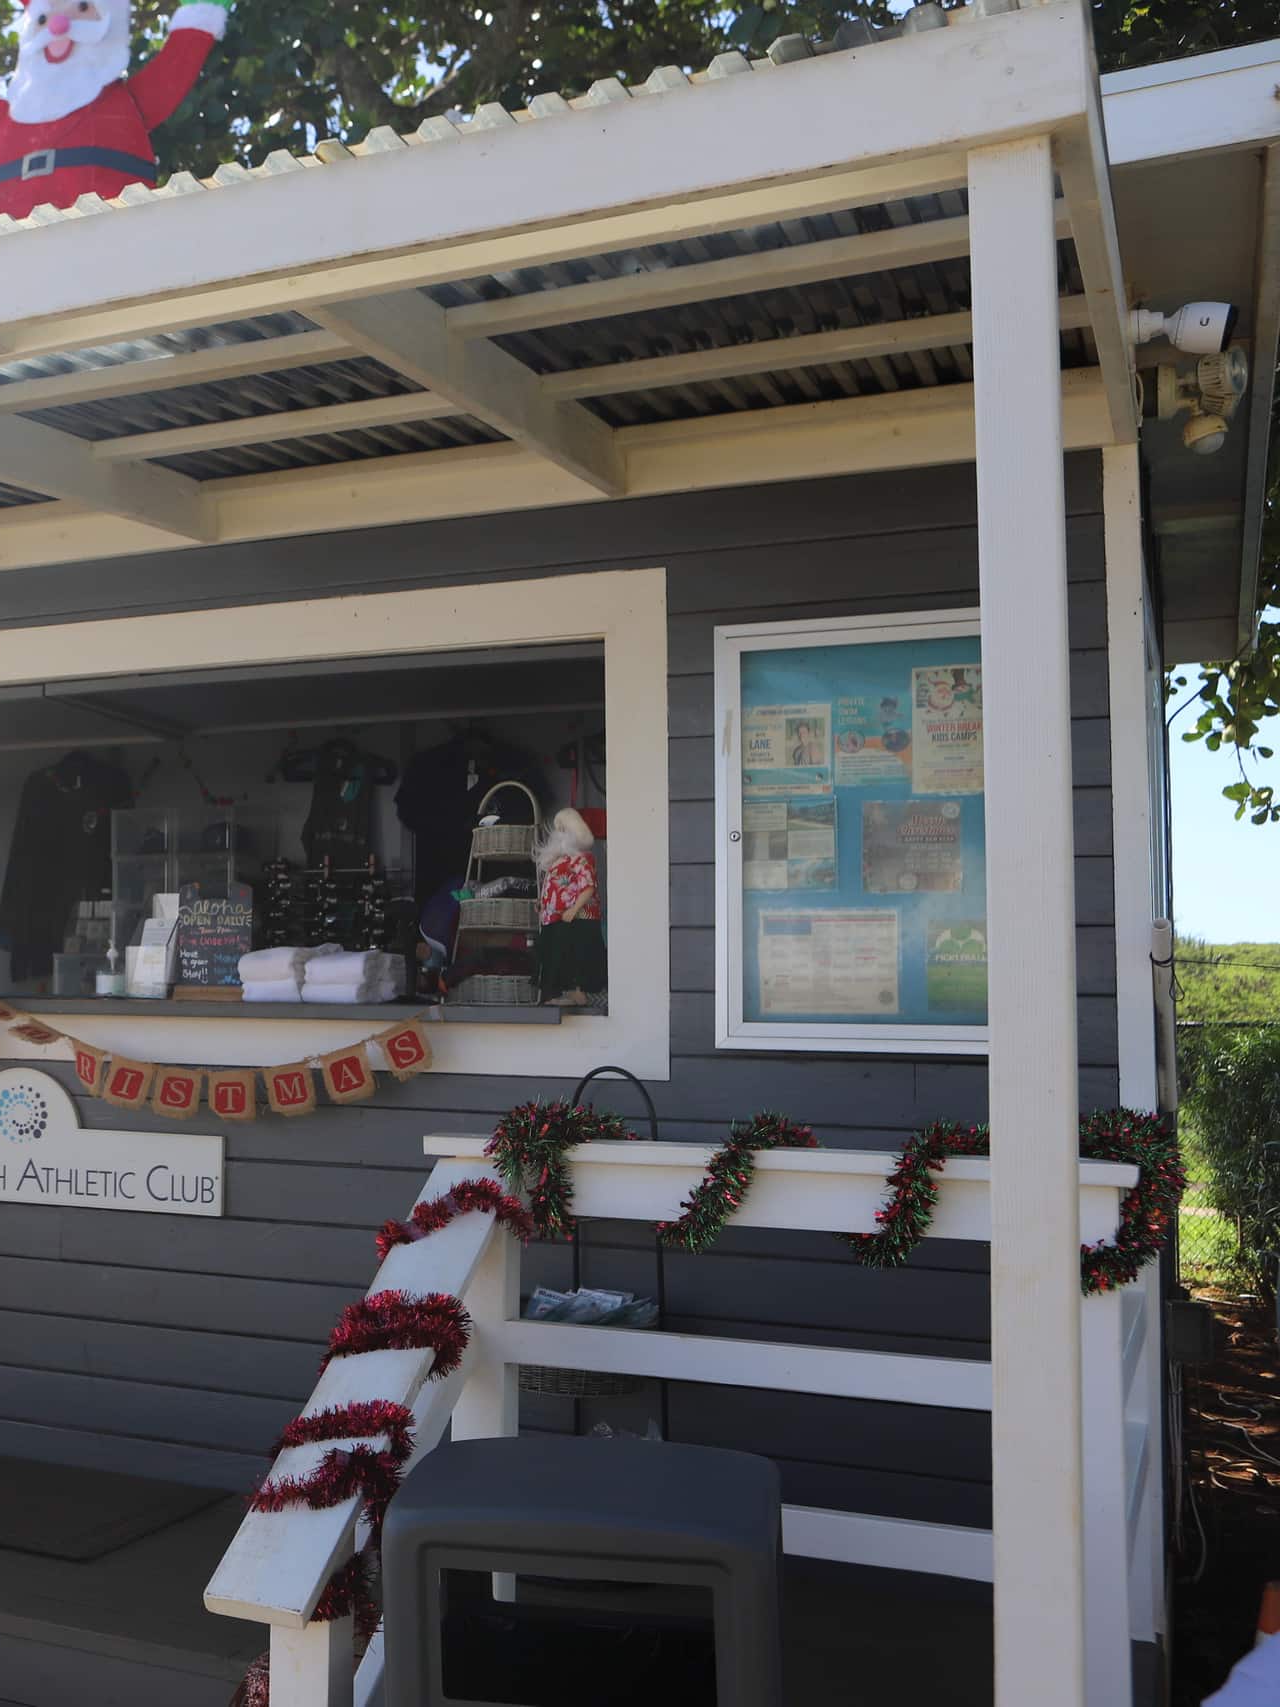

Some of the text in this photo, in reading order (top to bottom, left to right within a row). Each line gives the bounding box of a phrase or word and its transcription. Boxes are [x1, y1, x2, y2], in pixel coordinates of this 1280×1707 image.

[931, 730, 977, 742] KIDS CAMPS
[749, 739, 771, 750] LANE
[183, 914, 212, 926] OPEN
[22, 1024, 418, 1112] RISTMAS
